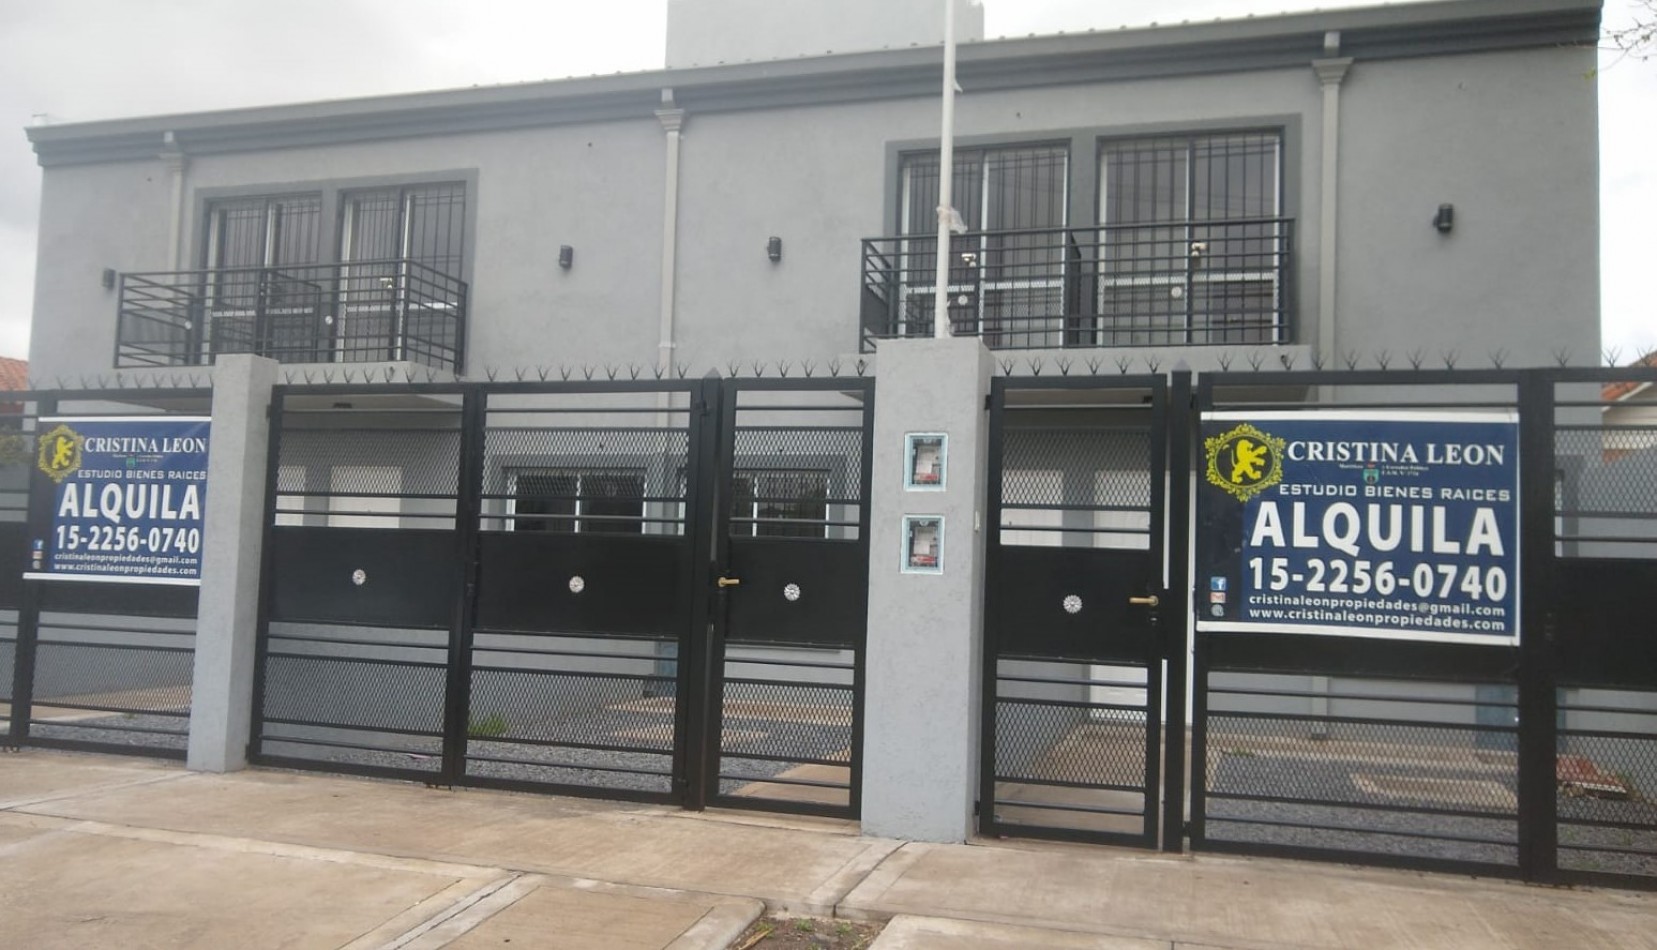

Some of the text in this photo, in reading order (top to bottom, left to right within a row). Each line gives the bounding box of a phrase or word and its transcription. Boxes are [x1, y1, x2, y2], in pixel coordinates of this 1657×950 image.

[84, 437, 207, 454] CRISTINA LEON
[1287, 441, 1505, 465] CRISTINA LEON
[77, 469, 207, 480] ESTUDIO BIENES RAICES
[58, 483, 200, 523] ALQUILA
[1279, 484, 1510, 501] ESTUDIO BIENES RAICES
[57, 525, 200, 553] 15-2256-0740
[1250, 500, 1504, 556] ALQUILA
[53, 562, 197, 575] www.cristinaleonpropiedades.com
[54, 552, 198, 565] cristinaleonpropiedades@gmail.com
[1249, 557, 1507, 601] 15-2256-0740
[1249, 594, 1505, 616] cristinaleonpropiedades@gmail.com
[1249, 608, 1505, 631] www.cristinaleonpropiedades.com
